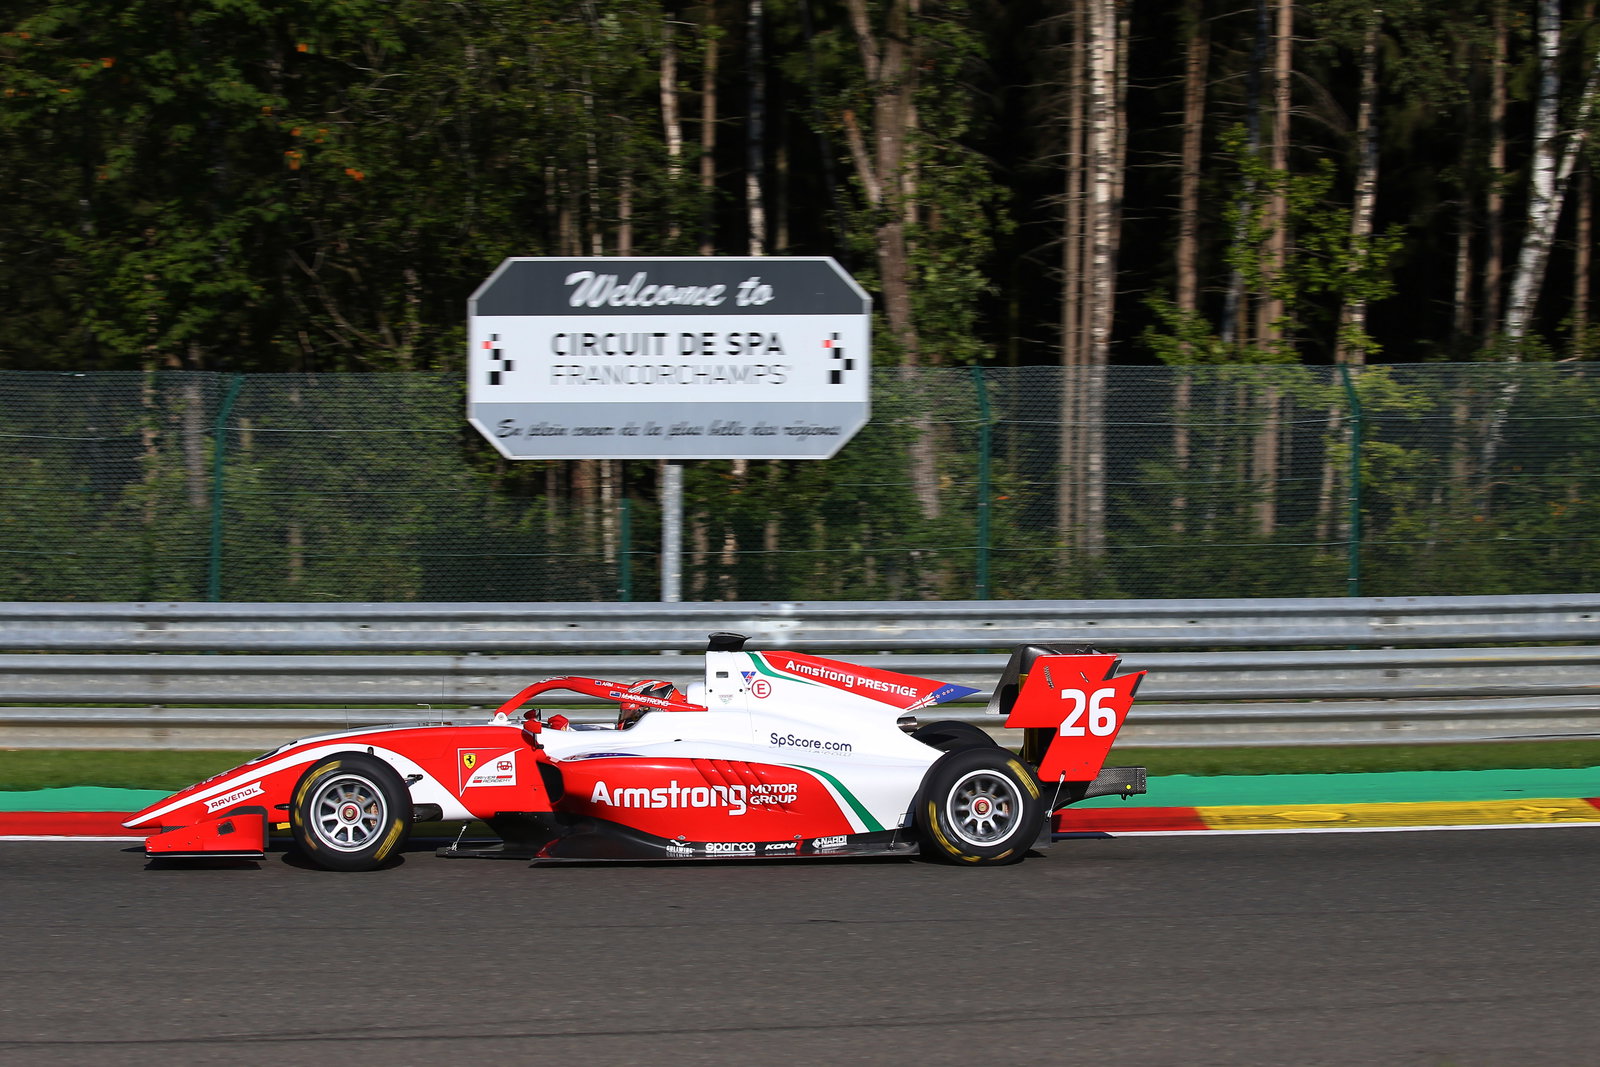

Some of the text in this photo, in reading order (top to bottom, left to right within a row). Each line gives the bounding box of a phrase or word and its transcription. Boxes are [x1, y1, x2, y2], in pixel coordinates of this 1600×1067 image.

[564, 270, 775, 307] Welcome to
[551, 332, 787, 356] CIRCUIT DE SPA
[550, 365, 788, 385] FRANCORCHAMPS
[757, 683, 767, 695] E
[785, 660, 918, 698] Armstrong PRESTIGE
[1060, 688, 1117, 736] 26
[770, 732, 852, 752] SpScore.com
[211, 788, 258, 808] RAVENOL
[590, 780, 747, 816] Armstrong
[750, 783, 798, 795] MOTOR
[750, 794, 798, 805] GROUP
[705, 842, 756, 854] sparco
[765, 842, 798, 850] KONI
[820, 835, 847, 845] NARDI
